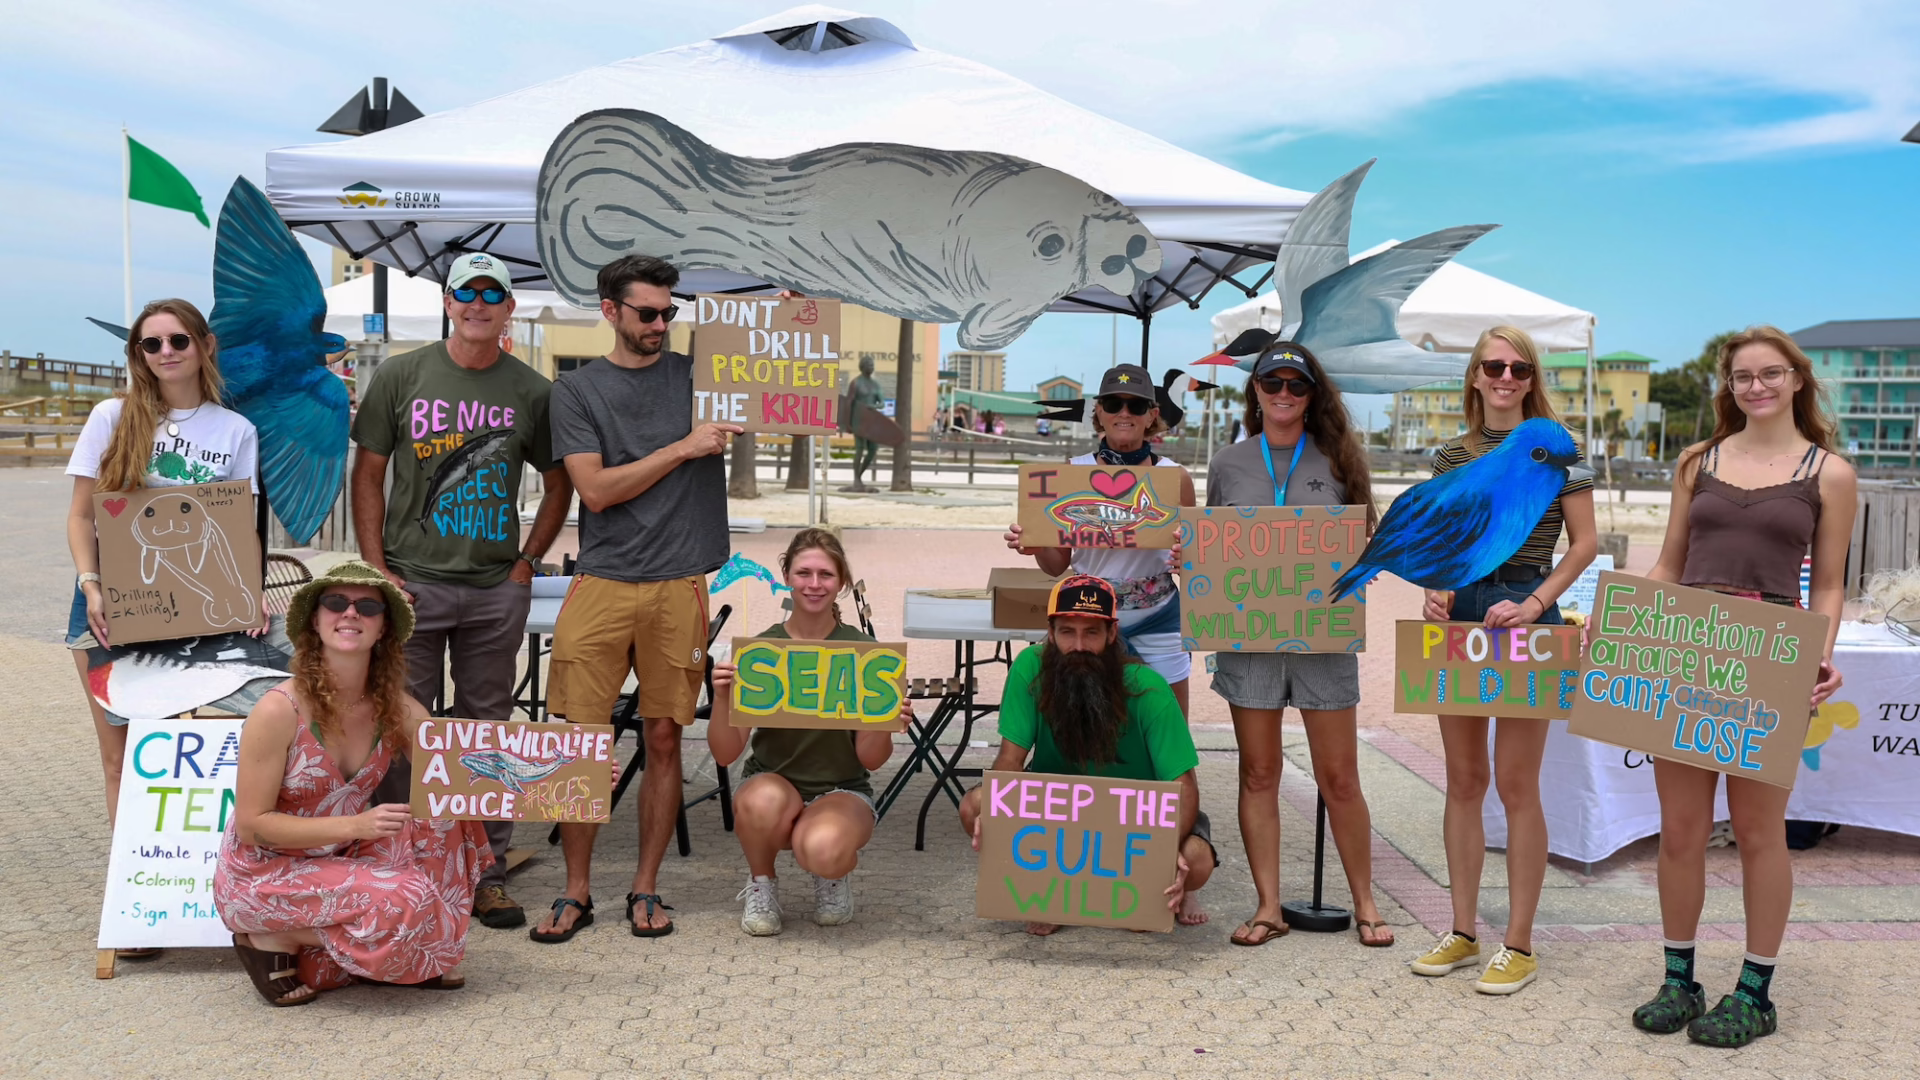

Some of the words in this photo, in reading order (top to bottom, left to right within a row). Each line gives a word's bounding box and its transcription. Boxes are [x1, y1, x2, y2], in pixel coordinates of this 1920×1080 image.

[395, 191, 440, 203] CROWN
[749, 329, 838, 359] DRILL
[712, 353, 838, 388] PROTECT
[411, 399, 449, 439] BE
[457, 400, 515, 432] NICE
[695, 391, 749, 422] THE
[762, 392, 838, 429] KRILL
[413, 442, 432, 460] TO
[431, 433, 464, 454] THE
[197, 487, 212, 497] OH
[439, 462, 508, 511] RICE'S
[1028, 470, 1057, 498] I
[433, 504, 510, 541] WHALE
[1058, 529, 1136, 547] WHALE
[1197, 519, 1365, 564] PROTECT
[108, 588, 162, 606] Drilling
[1223, 563, 1314, 603] GULF
[1187, 606, 1356, 640] WILDLIFE
[1601, 584, 1765, 657] Extinction
[1770, 621, 1799, 664] is
[1423, 624, 1577, 662] PROTECT
[736, 644, 905, 720] SEAS
[1400, 668, 1579, 709] WILDLIFE
[1705, 655, 1747, 694] we
[1675, 686, 1748, 724] afford
[1755, 702, 1778, 731] to
[418, 721, 493, 750] GIVE
[1673, 714, 1768, 771] LOSE
[422, 752, 450, 786] A
[990, 778, 1094, 822] KEEP
[1109, 787, 1179, 828] THE
[140, 845, 191, 859] Whale
[1012, 824, 1152, 877] GULF
[134, 871, 195, 894] Coloring
[1003, 875, 1140, 919] WILD
[131, 902, 168, 927] Sign
